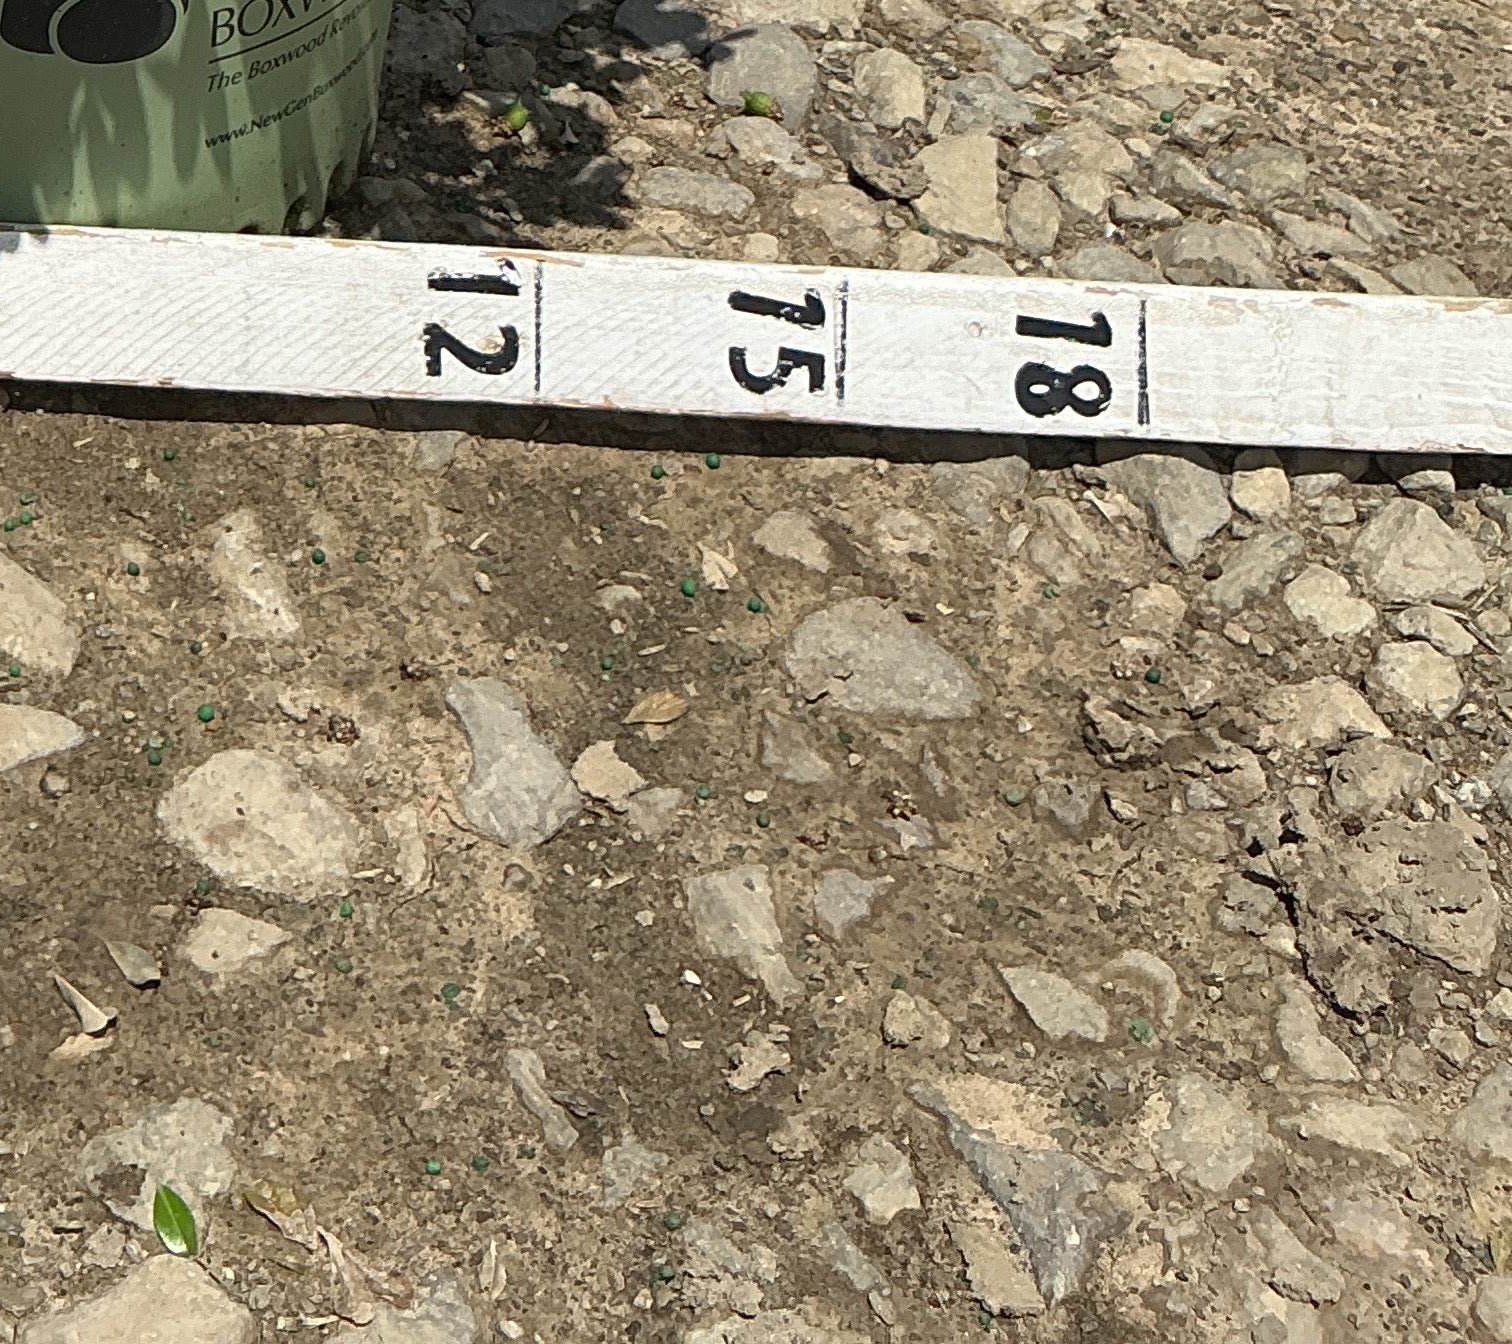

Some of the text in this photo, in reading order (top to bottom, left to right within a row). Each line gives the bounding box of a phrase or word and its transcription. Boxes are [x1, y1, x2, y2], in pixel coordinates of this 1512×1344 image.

[206, 23, 329, 93] The Boxwood
[423, 257, 521, 377] 12
[727, 286, 826, 396] 15
[1014, 309, 1113, 418] 18
